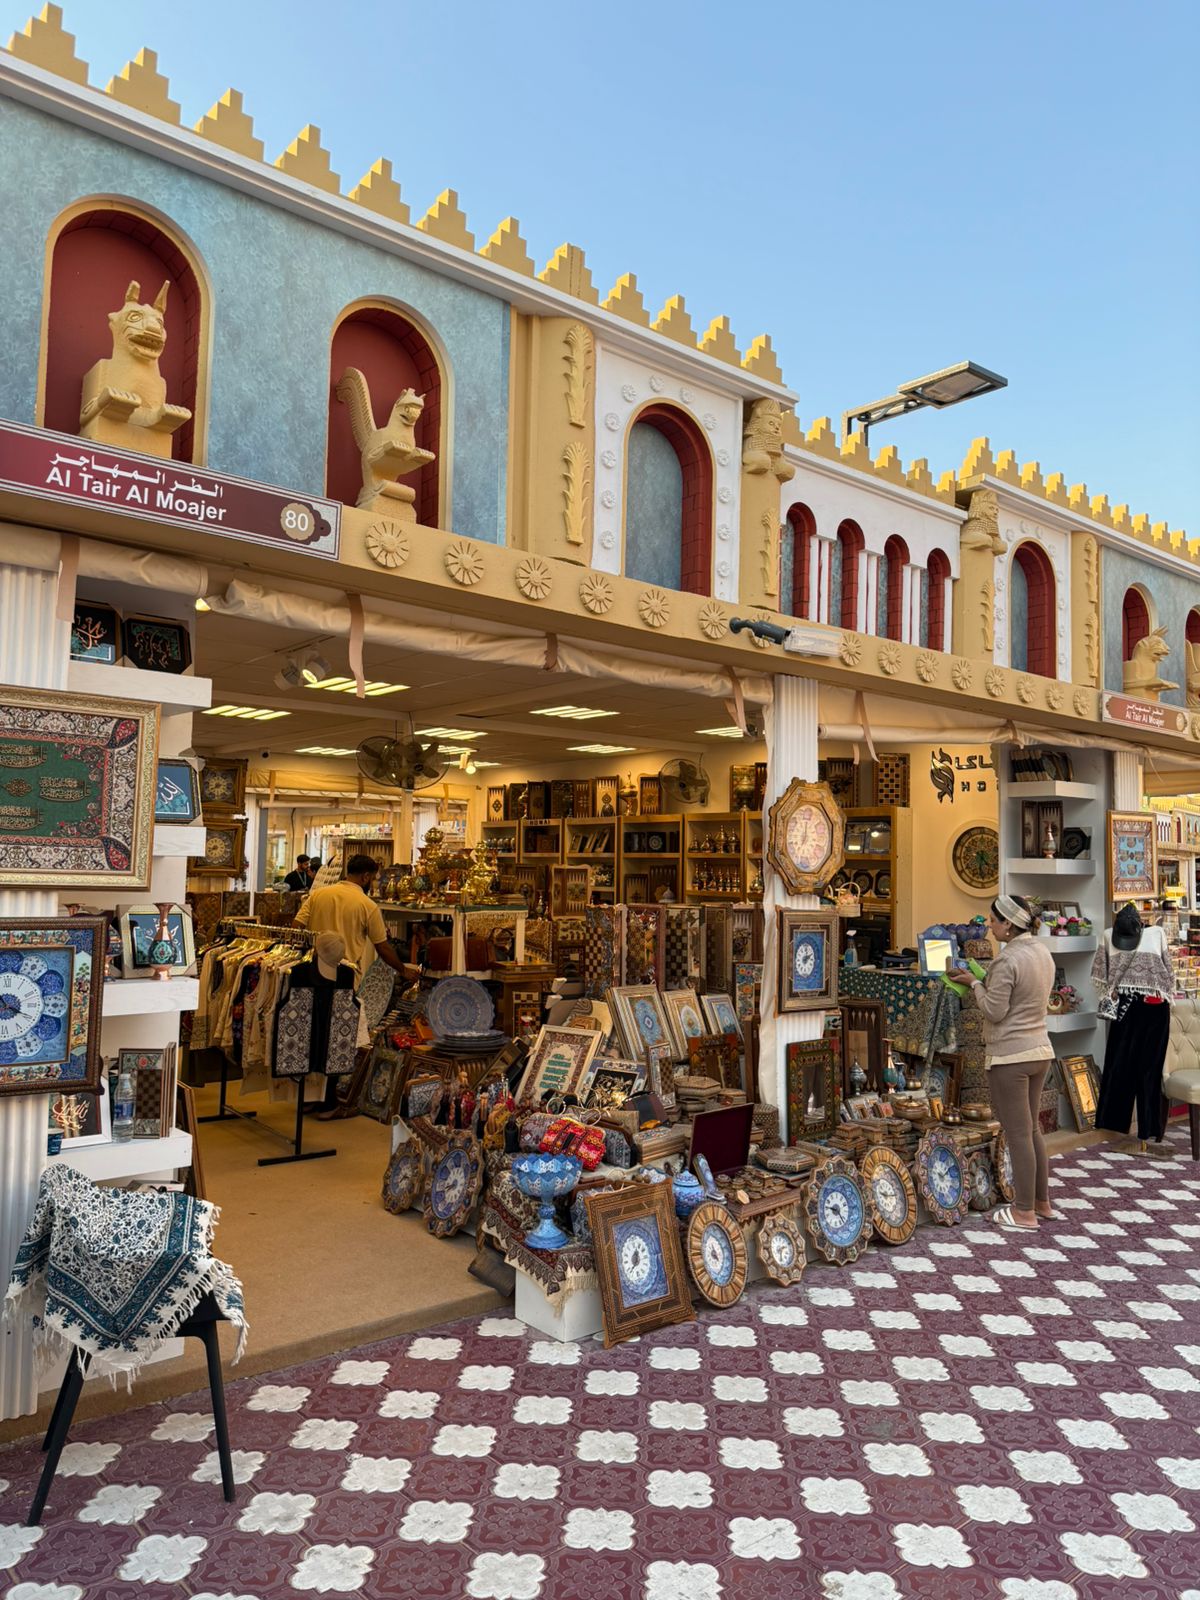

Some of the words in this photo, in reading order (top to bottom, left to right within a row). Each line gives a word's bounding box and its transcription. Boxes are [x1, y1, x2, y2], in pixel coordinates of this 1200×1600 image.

[50, 453, 165, 485] المهاجر
[46, 466, 71, 488] Al
[78, 472, 121, 498] Tair
[125, 484, 149, 505] Al
[156, 490, 227, 521] Moajer
[285, 510, 308, 531] 80
